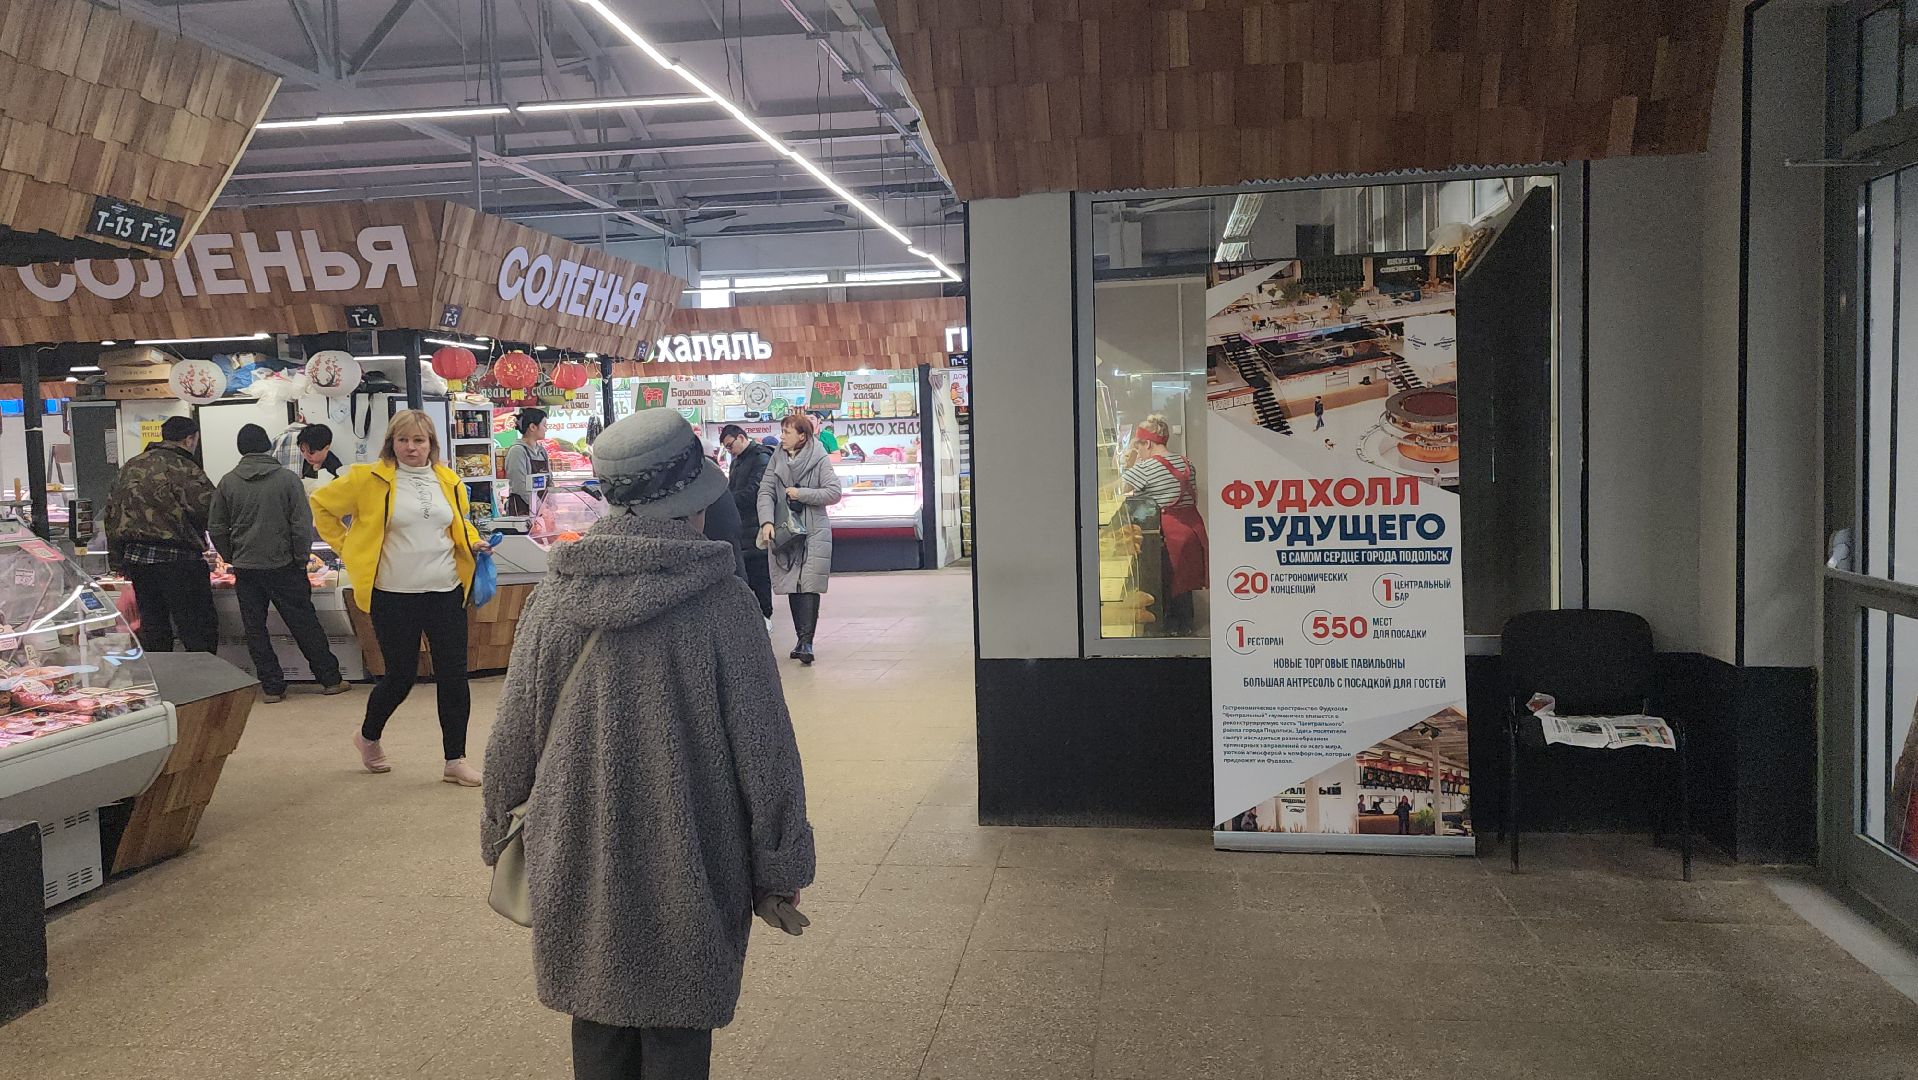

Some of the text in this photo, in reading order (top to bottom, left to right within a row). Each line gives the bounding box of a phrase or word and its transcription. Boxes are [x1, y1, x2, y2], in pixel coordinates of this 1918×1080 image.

[96, 210, 176, 248] Т-13 Т-12
[498, 246, 648, 328] СОЛЕНЬЯ
[352, 313, 378, 326] Т-4
[444, 312, 458, 326] Т-3
[1221, 476, 1419, 513] ФУДХОЛЛ
[1244, 513, 1445, 546] БУДУЩЕГО
[1281, 550, 1448, 564] В САМОМ СЕРДЦЕ ГОРОДА ПОДОЛЬСК
[1233, 572, 1348, 594] 20 ГАСТРОНОМИЧЕСКИХ
[1270, 583, 1316, 595] КОНЦЕПЦИЙ
[1382, 578, 1451, 601] 1 ЦЕНТРАЛЬНЫЙ
[1394, 592, 1410, 601] БАР
[1312, 616, 1392, 639] 550 МЕСТ
[1373, 629, 1426, 640] ДЛЯ ПОСАДКИ
[1236, 626, 1284, 648] 1 РЕСТОРАН
[1273, 658, 1405, 669] НОВЫЕ ТОРГОВЫЕ ПАВИЛЬОНЫ
[1244, 676, 1446, 690] БОЛЬШАЯ АНТРЕСОЛЬ С ПОСАДКОЙ ДЛЯ ГОСТЕЙ
